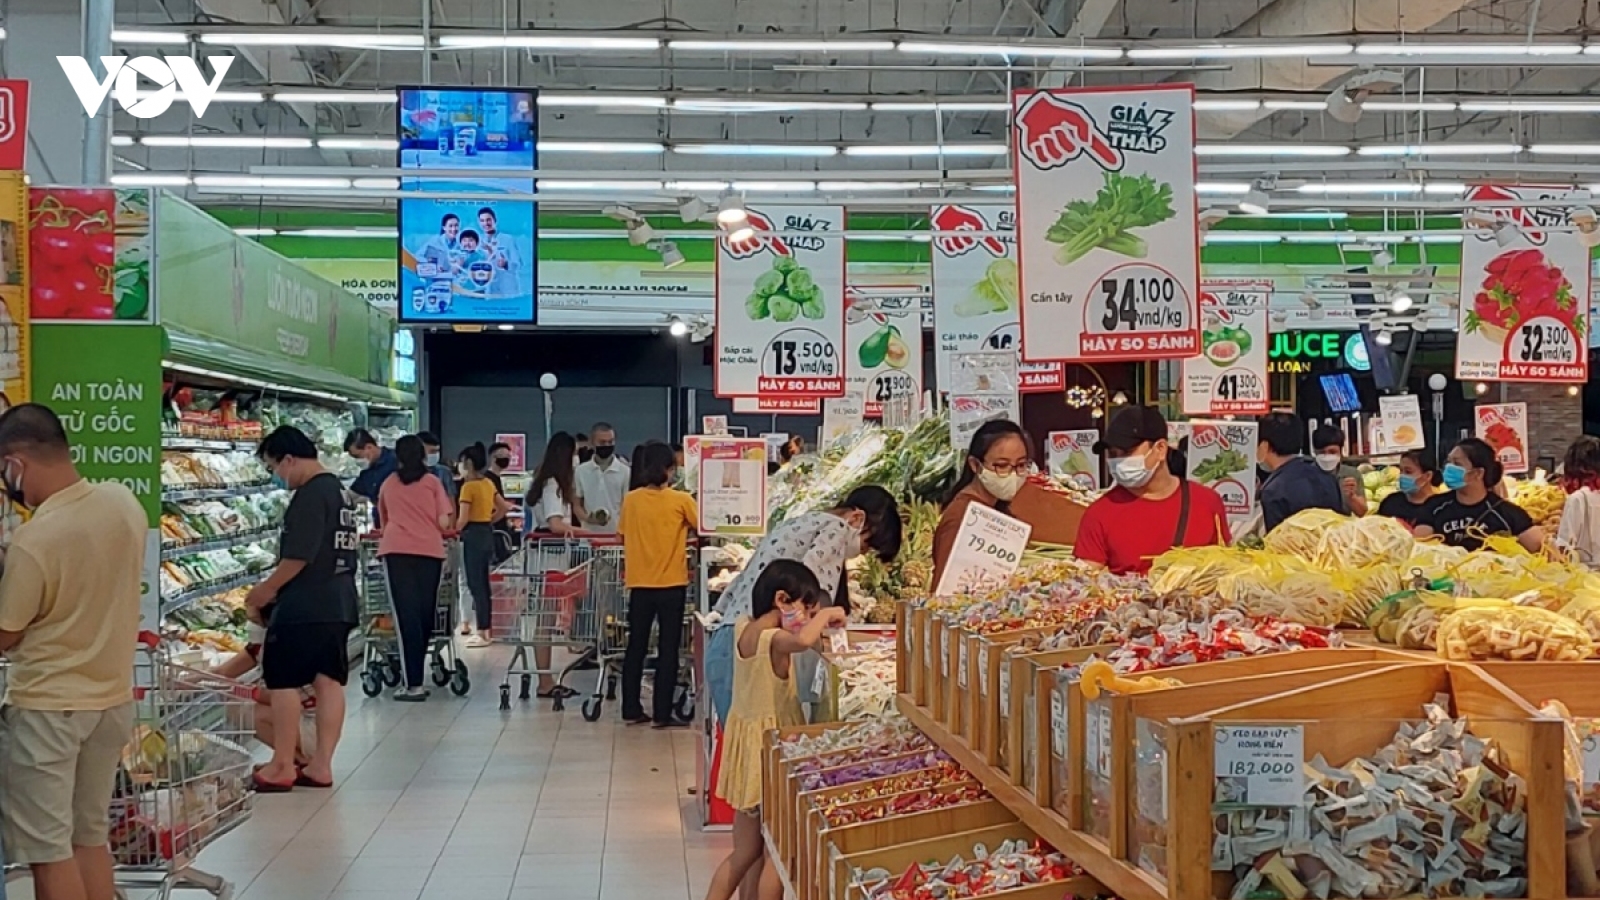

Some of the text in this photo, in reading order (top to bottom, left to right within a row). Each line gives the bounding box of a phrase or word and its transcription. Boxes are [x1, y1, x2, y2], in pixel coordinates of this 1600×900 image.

[1110, 101, 1148, 123] GIÁ
[786, 213, 814, 230] GIÁ
[1136, 306, 1182, 327] vnd/kg
[1120, 337, 1144, 351] SO
[1147, 334, 1194, 350] SÁNH
[799, 359, 833, 375] vnd/kg
[1277, 361, 1311, 373] LOAN
[1529, 366, 1547, 376] SO
[1549, 364, 1584, 377] SÁNH
[787, 380, 805, 391] SO
[806, 378, 841, 391] SÁNH
[1024, 372, 1059, 385] SÁNH
[51, 378, 144, 401] AN TOÀN
[92, 406, 136, 432] GỐC
[93, 446, 153, 464] NGON
[725, 514, 742, 525] 10
[968, 533, 1017, 563] 79.000
[1229, 760, 1295, 776] 182.000
